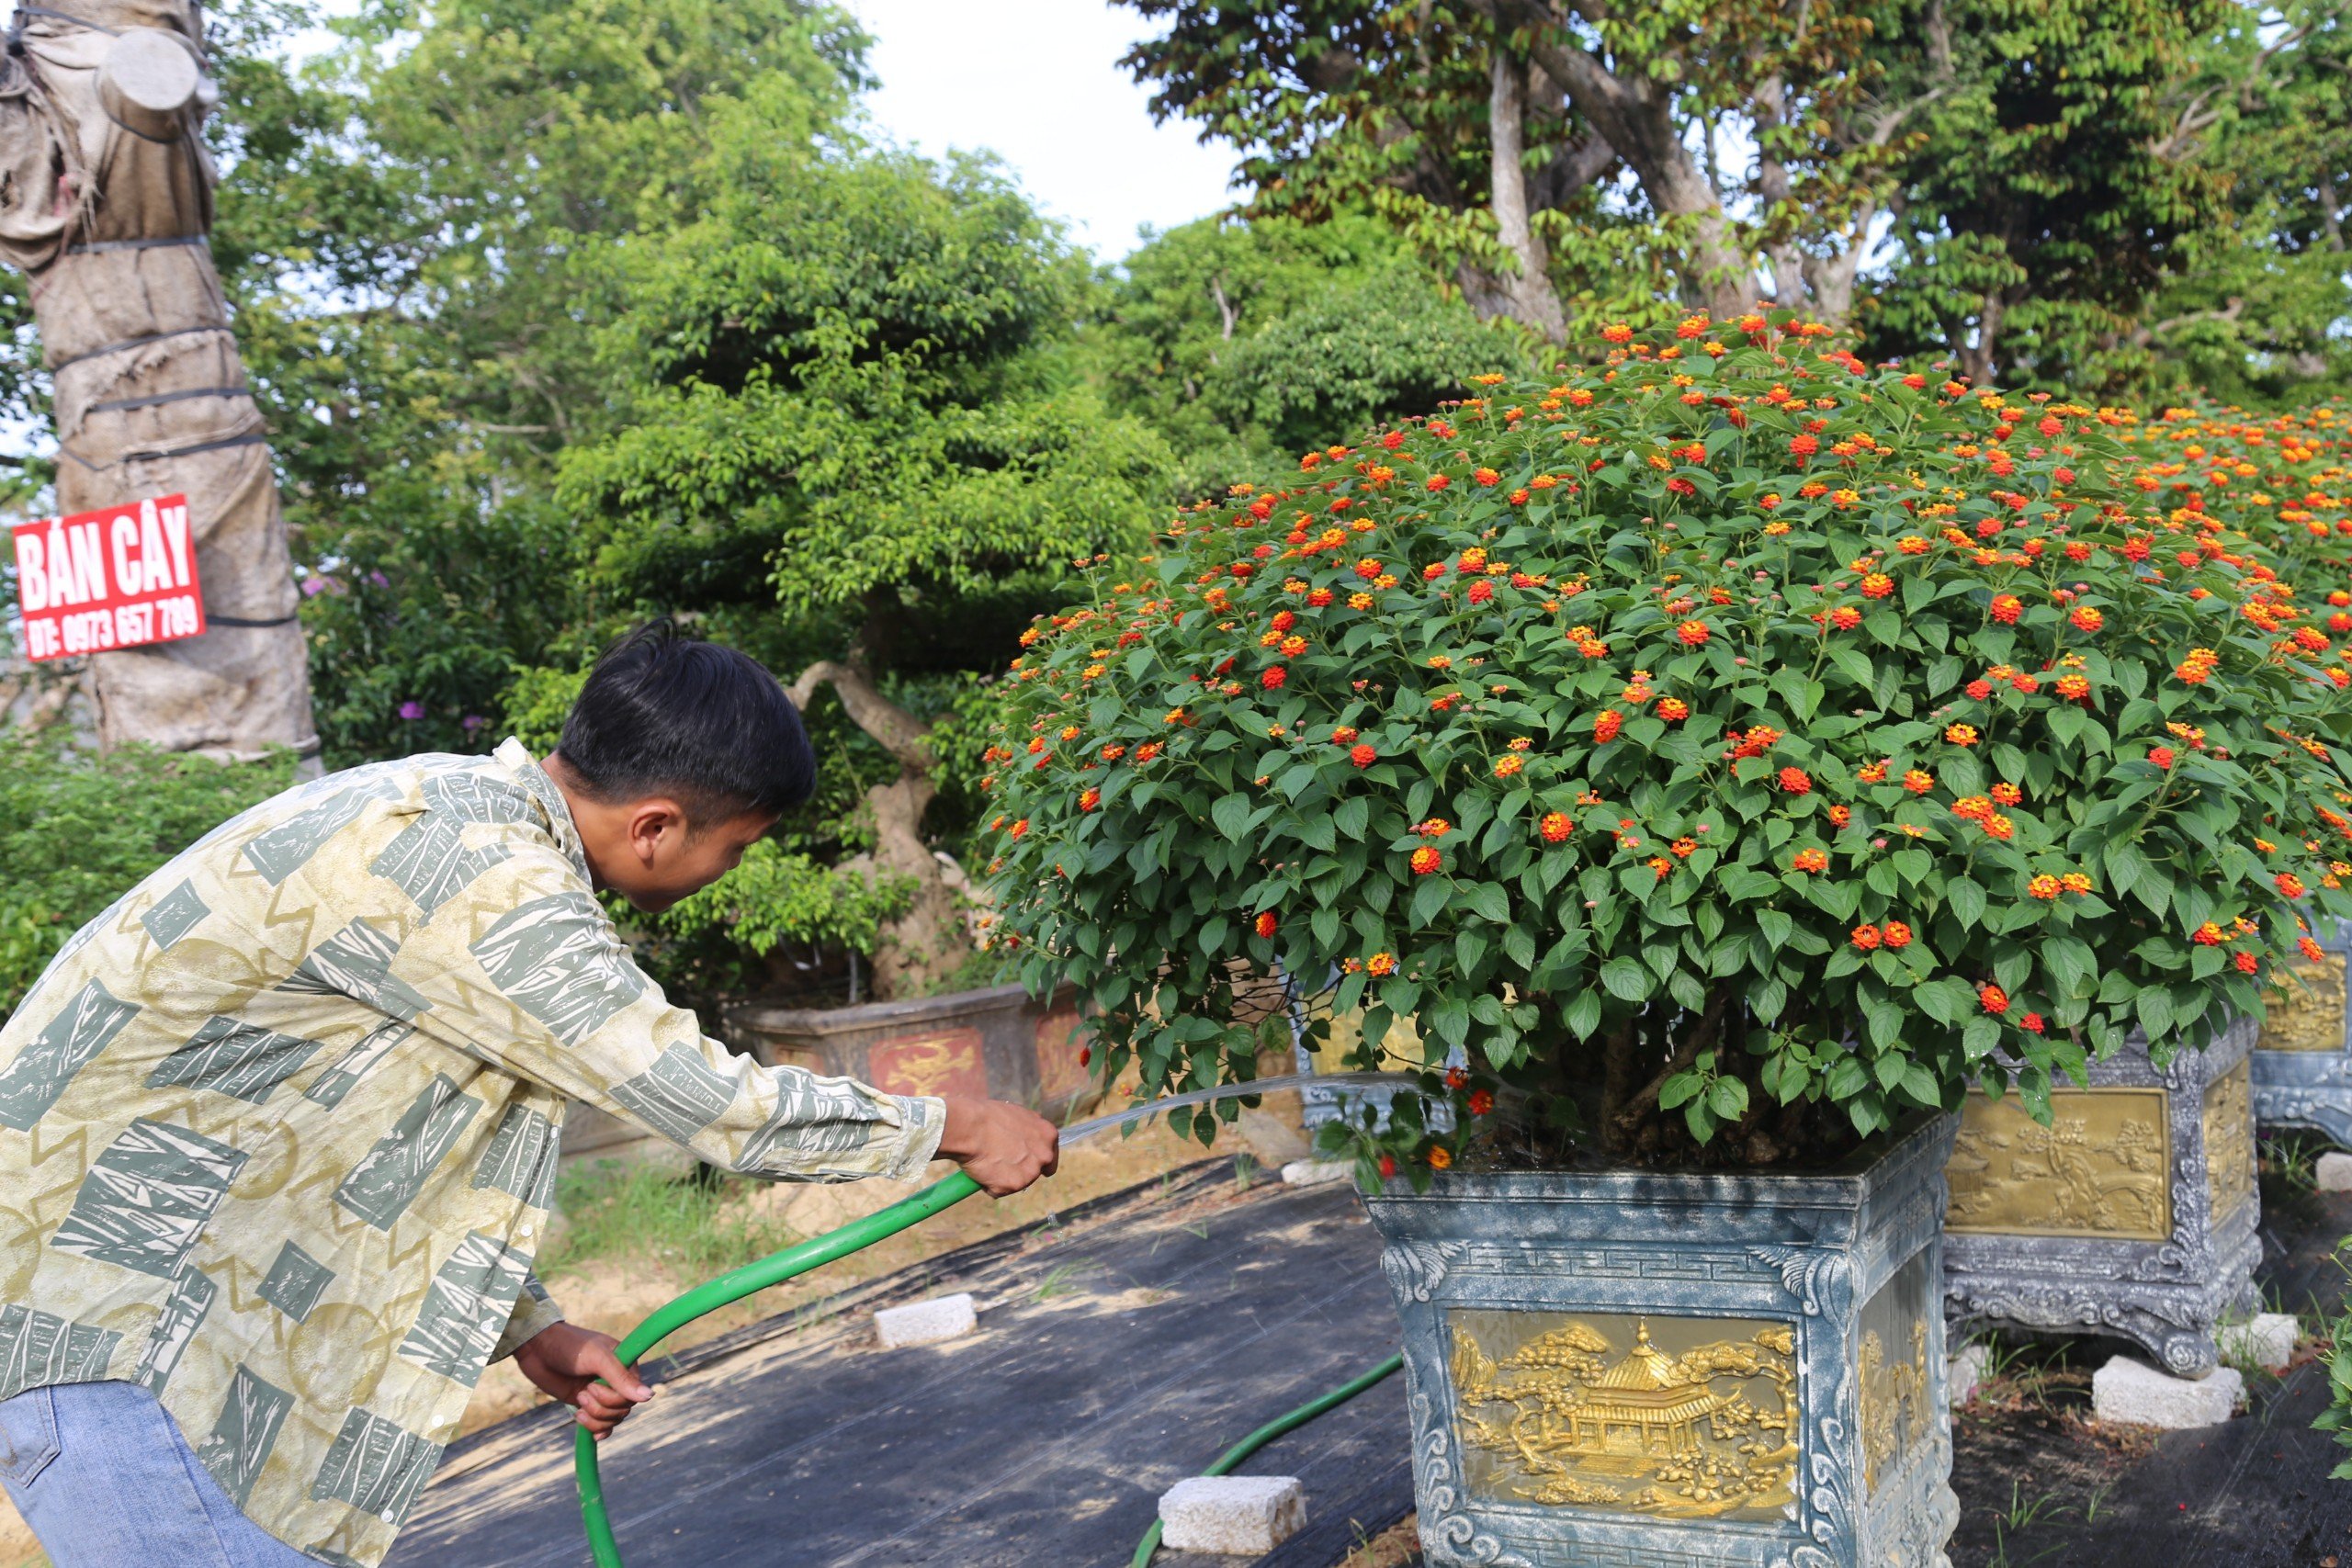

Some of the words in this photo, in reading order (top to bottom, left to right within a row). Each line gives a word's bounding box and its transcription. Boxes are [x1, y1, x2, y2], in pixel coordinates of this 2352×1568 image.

[16, 516, 107, 612] BÁN
[110, 499, 190, 596] CÂY
[62, 609, 114, 652] 0973
[115, 602, 153, 645] 657
